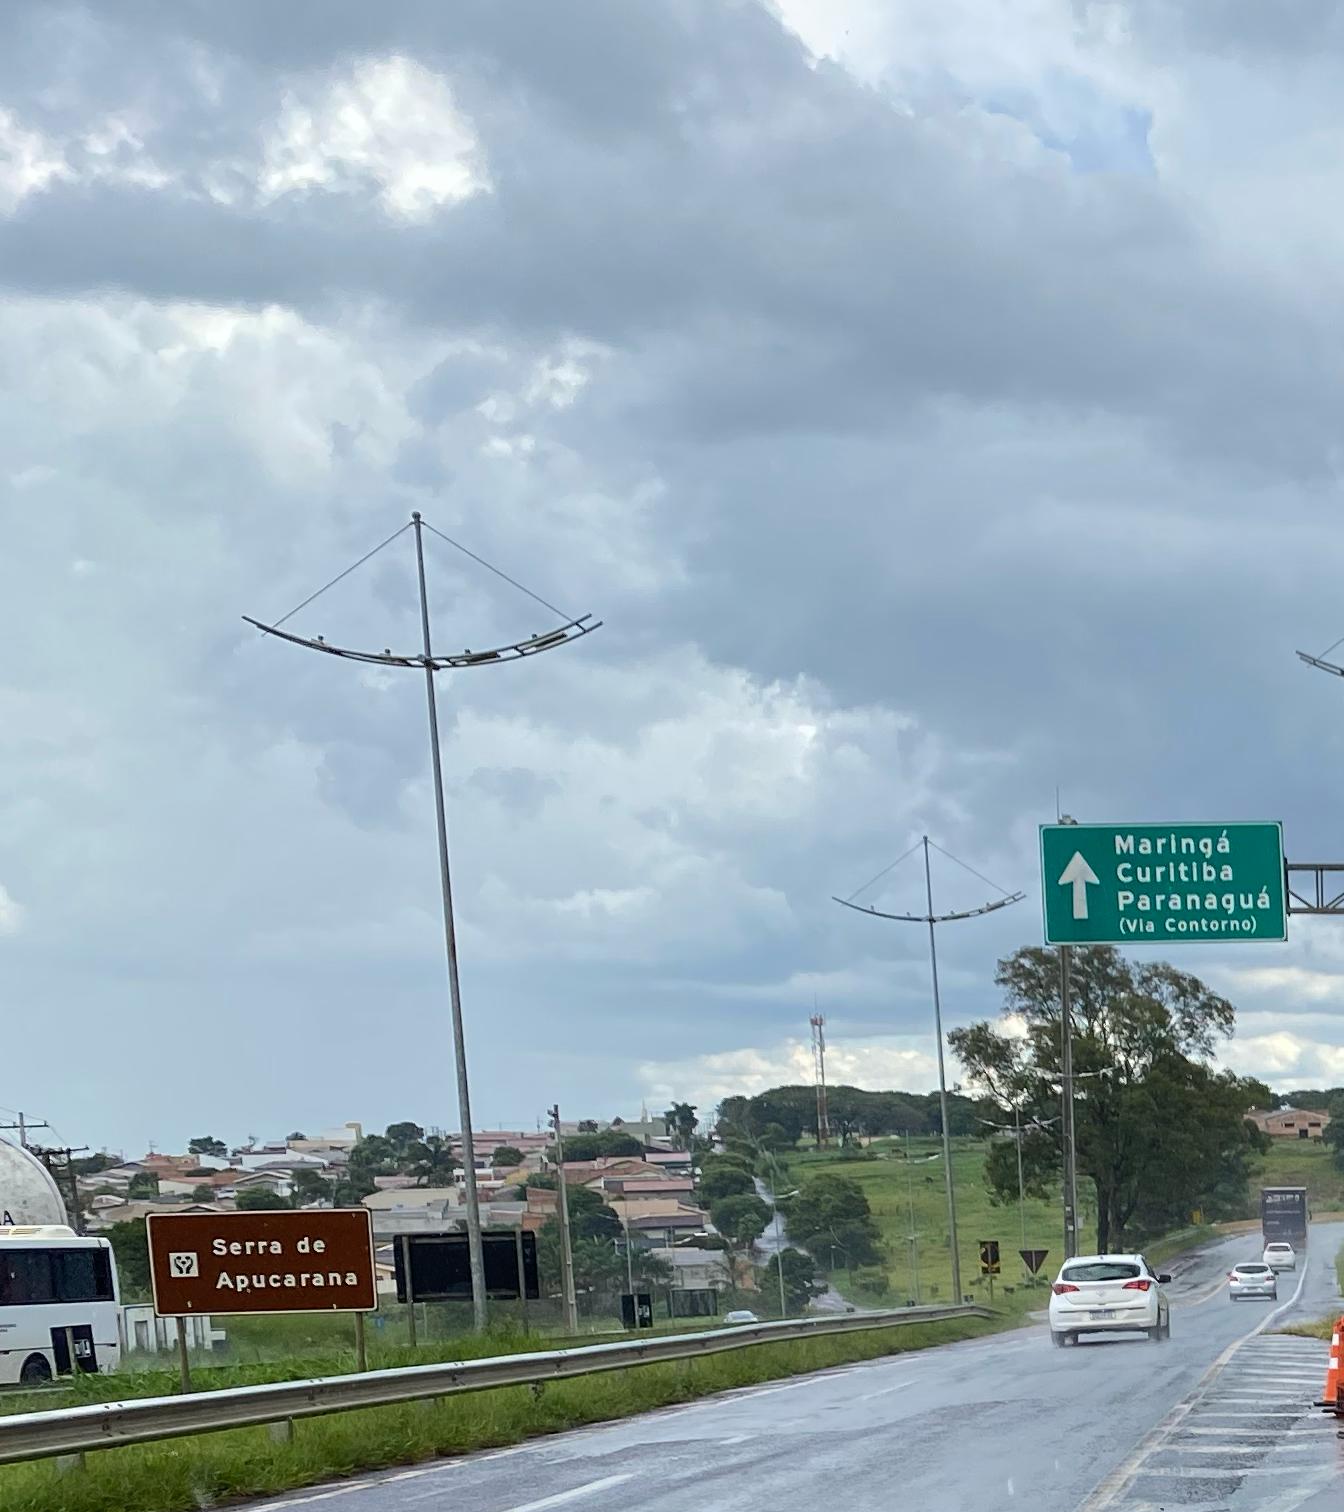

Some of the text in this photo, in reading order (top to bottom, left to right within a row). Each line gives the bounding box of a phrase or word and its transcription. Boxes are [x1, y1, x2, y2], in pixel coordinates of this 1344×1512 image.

[1114, 829, 1231, 859] Maringá
[1116, 861, 1234, 883] Curitiba
[1117, 885, 1271, 914] Paranaguá
[1119, 915, 1257, 935] (Via Contorno)
[212, 1236, 327, 1256] Serra de
[215, 1271, 359, 1292] Apucarana
